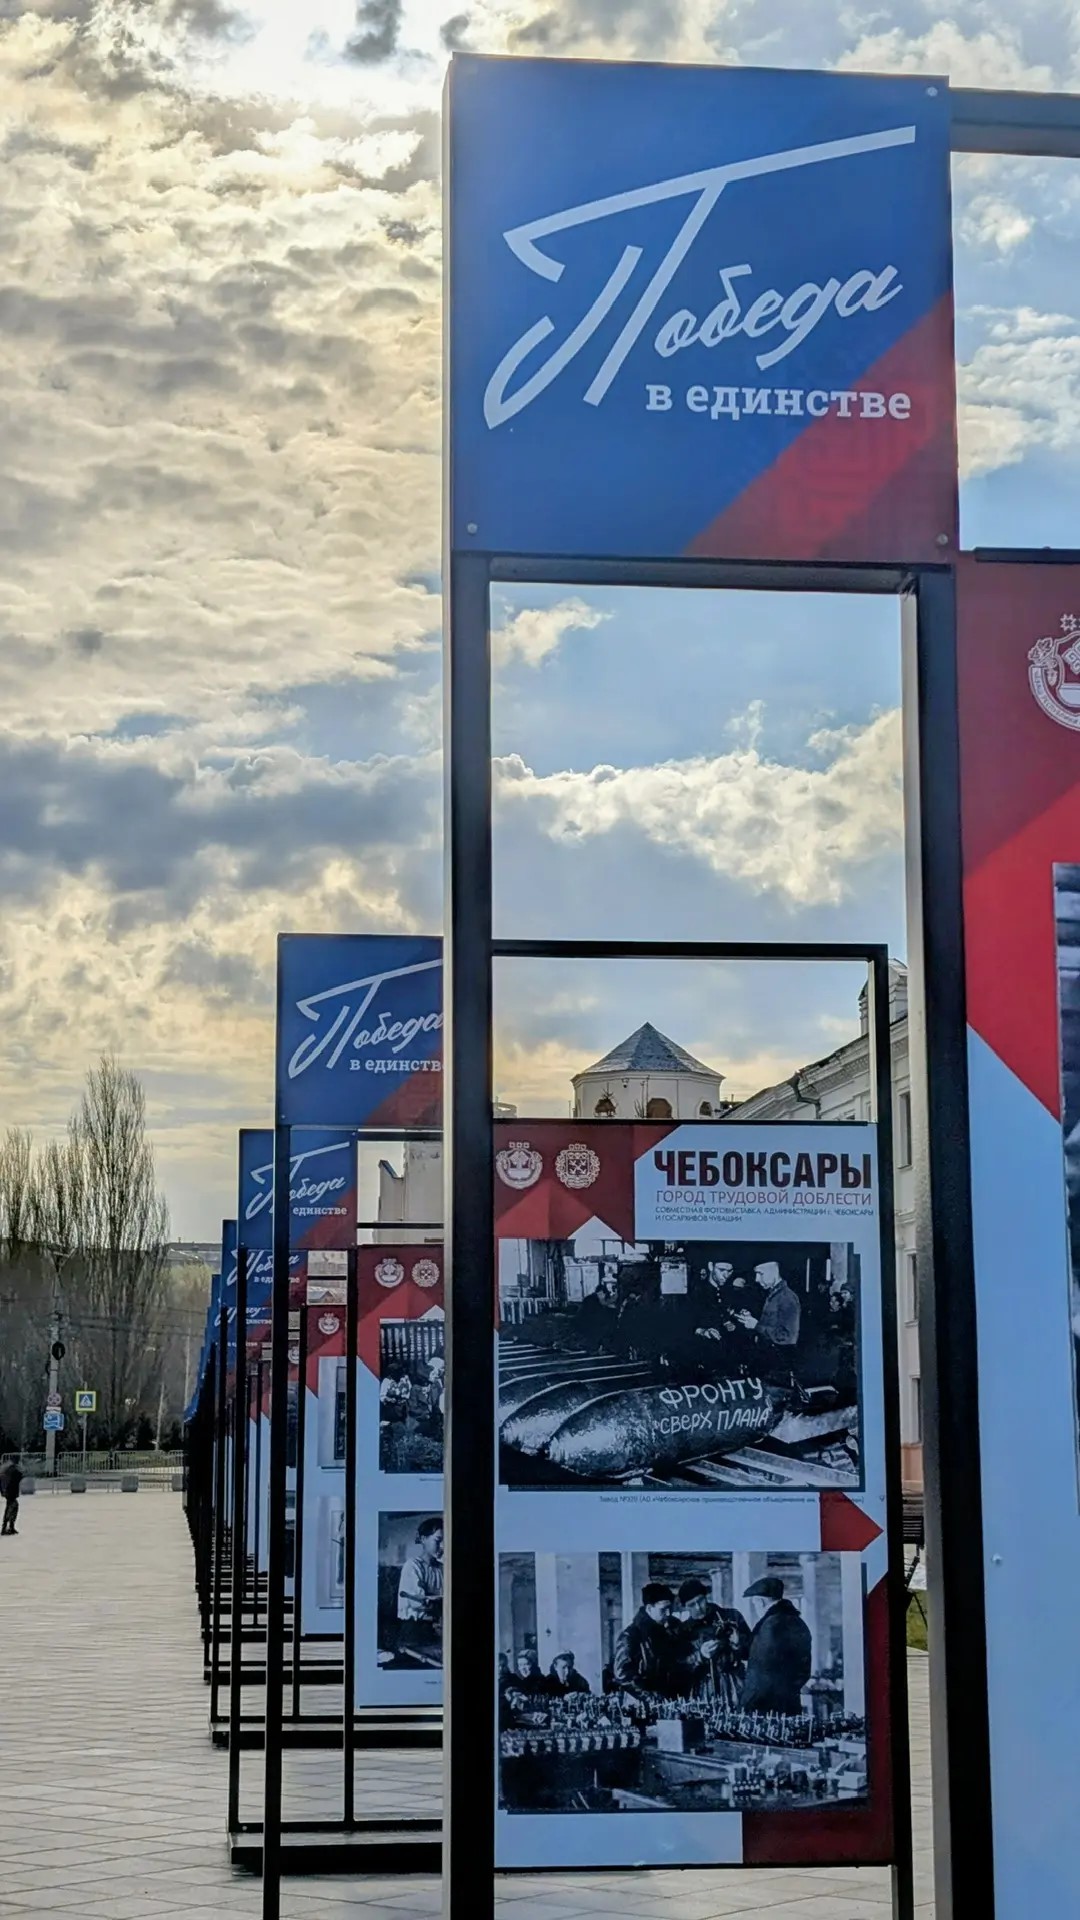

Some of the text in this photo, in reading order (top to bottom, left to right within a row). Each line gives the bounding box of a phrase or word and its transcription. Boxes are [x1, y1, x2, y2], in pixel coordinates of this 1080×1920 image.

[483, 125, 916, 429] Победа
[646, 383, 912, 421] в единстве
[288, 958, 443, 1079] Победа
[350, 1059, 443, 1073] в единств
[654, 1150, 872, 1189] ЧЕБОКСАРЫ
[292, 1207, 348, 1216] единстве
[656, 1190, 872, 1207] ГОРОД ТРУДОВОЙ ДОБЛЕСТИ
[834, 1208, 874, 1216] ЧЕБОКСАРЫ
[659, 1377, 763, 1409] ФРОНТУ
[717, 1406, 769, 1430] ПЛАНА
